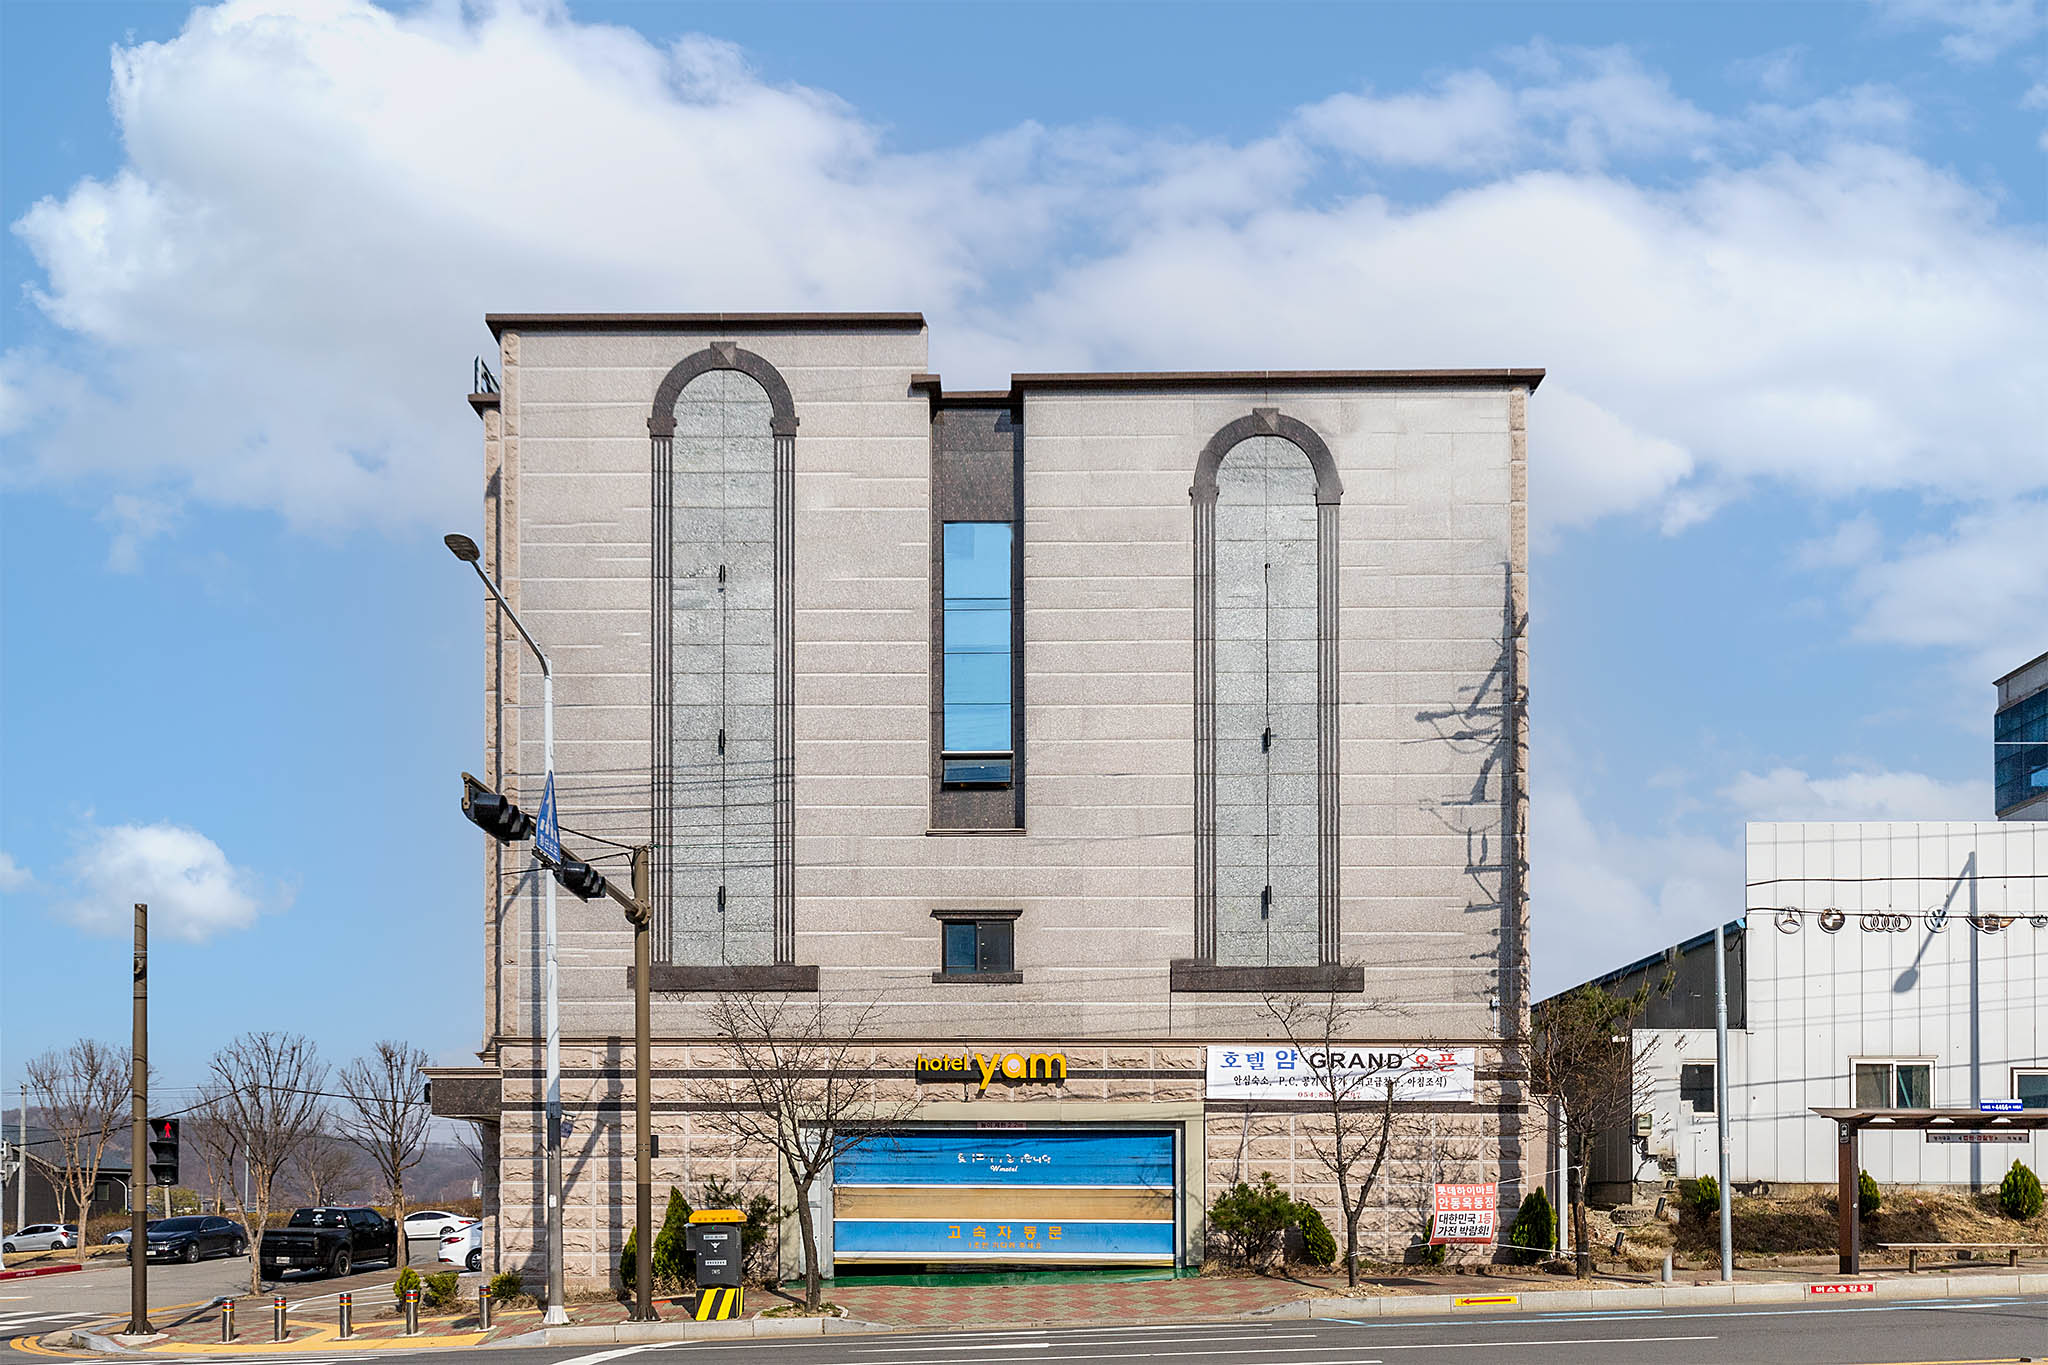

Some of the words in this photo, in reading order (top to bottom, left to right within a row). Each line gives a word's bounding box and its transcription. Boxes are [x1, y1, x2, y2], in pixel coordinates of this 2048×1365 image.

[1220, 1051, 1265, 1071] 호텔
[1275, 1049, 1298, 1070] 얌
[1309, 1052, 1403, 1069] GRAND
[1410, 1053, 1458, 1072] 오픈
[917, 1053, 968, 1071] hotel
[974, 1053, 1067, 1094] yam
[1437, 1185, 1494, 1196] 롯데하이마트
[1437, 1196, 1494, 1210] 안동옥동점
[1439, 1213, 1476, 1225] 대한민국
[1477, 1212, 1492, 1225] 1등
[1438, 1225, 1457, 1236] 가전
[1459, 1225, 1490, 1236] 박람회!
